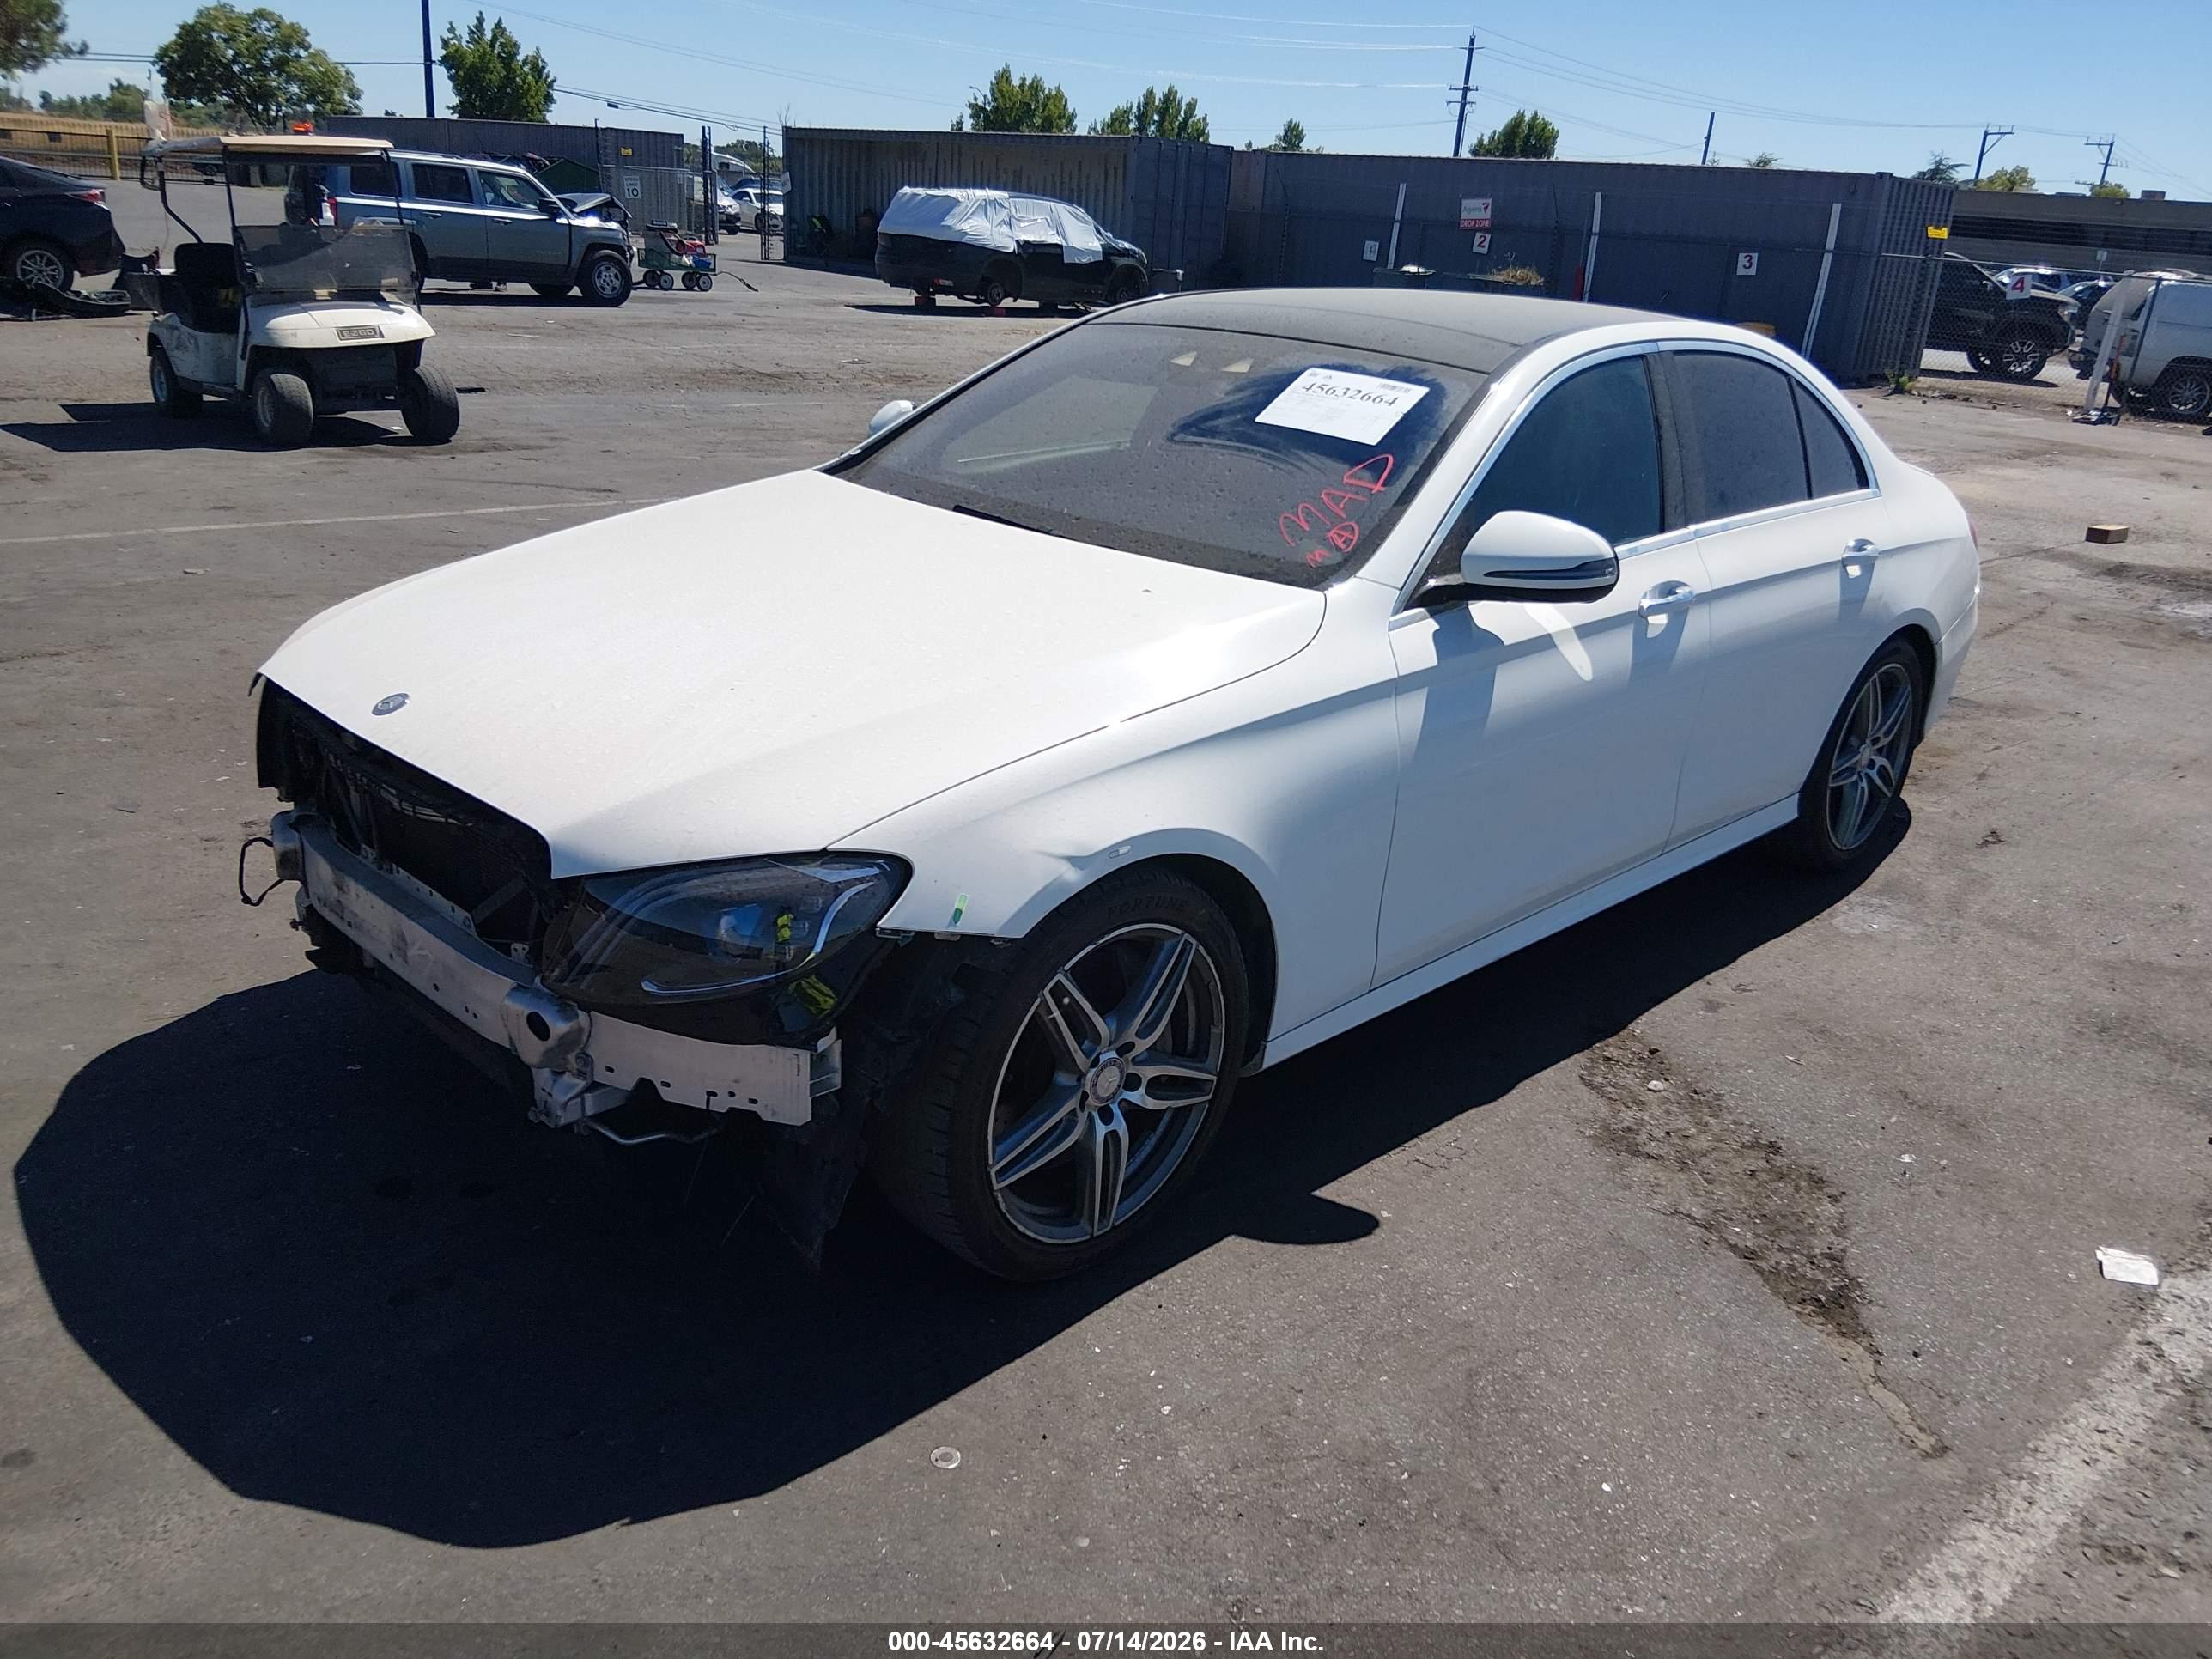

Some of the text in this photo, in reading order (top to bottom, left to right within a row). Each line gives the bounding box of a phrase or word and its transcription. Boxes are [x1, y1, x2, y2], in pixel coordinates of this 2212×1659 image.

[627, 187, 639, 198] 10
[1461, 219, 1490, 228] DROP ZONE
[1477, 234, 1487, 248] 2
[1743, 254, 1753, 270] 3
[2011, 276, 2025, 293] 4
[1302, 382, 1400, 407] 45632664
[1278, 453, 1395, 548] MAD
